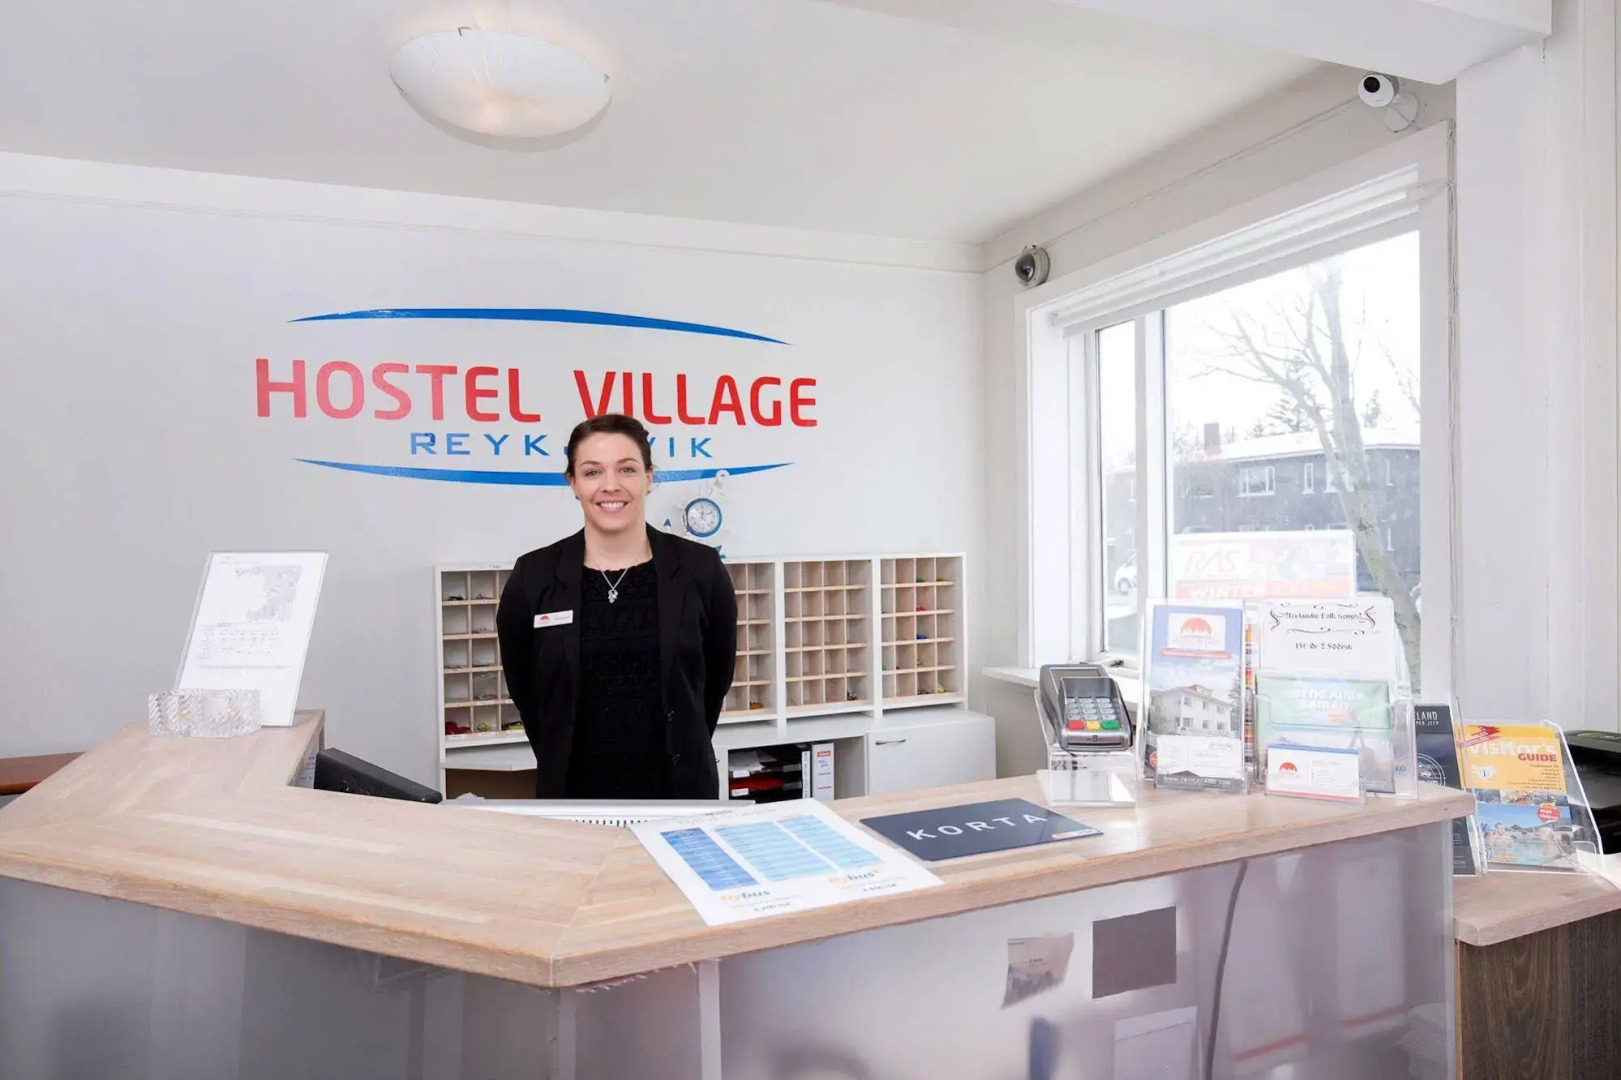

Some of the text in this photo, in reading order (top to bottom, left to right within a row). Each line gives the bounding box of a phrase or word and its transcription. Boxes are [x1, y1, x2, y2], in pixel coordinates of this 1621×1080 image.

[255, 358, 818, 428] HOSTEL VILLAGE
[1517, 752, 1558, 762] GUIDE
[906, 813, 1049, 841] KORTA
